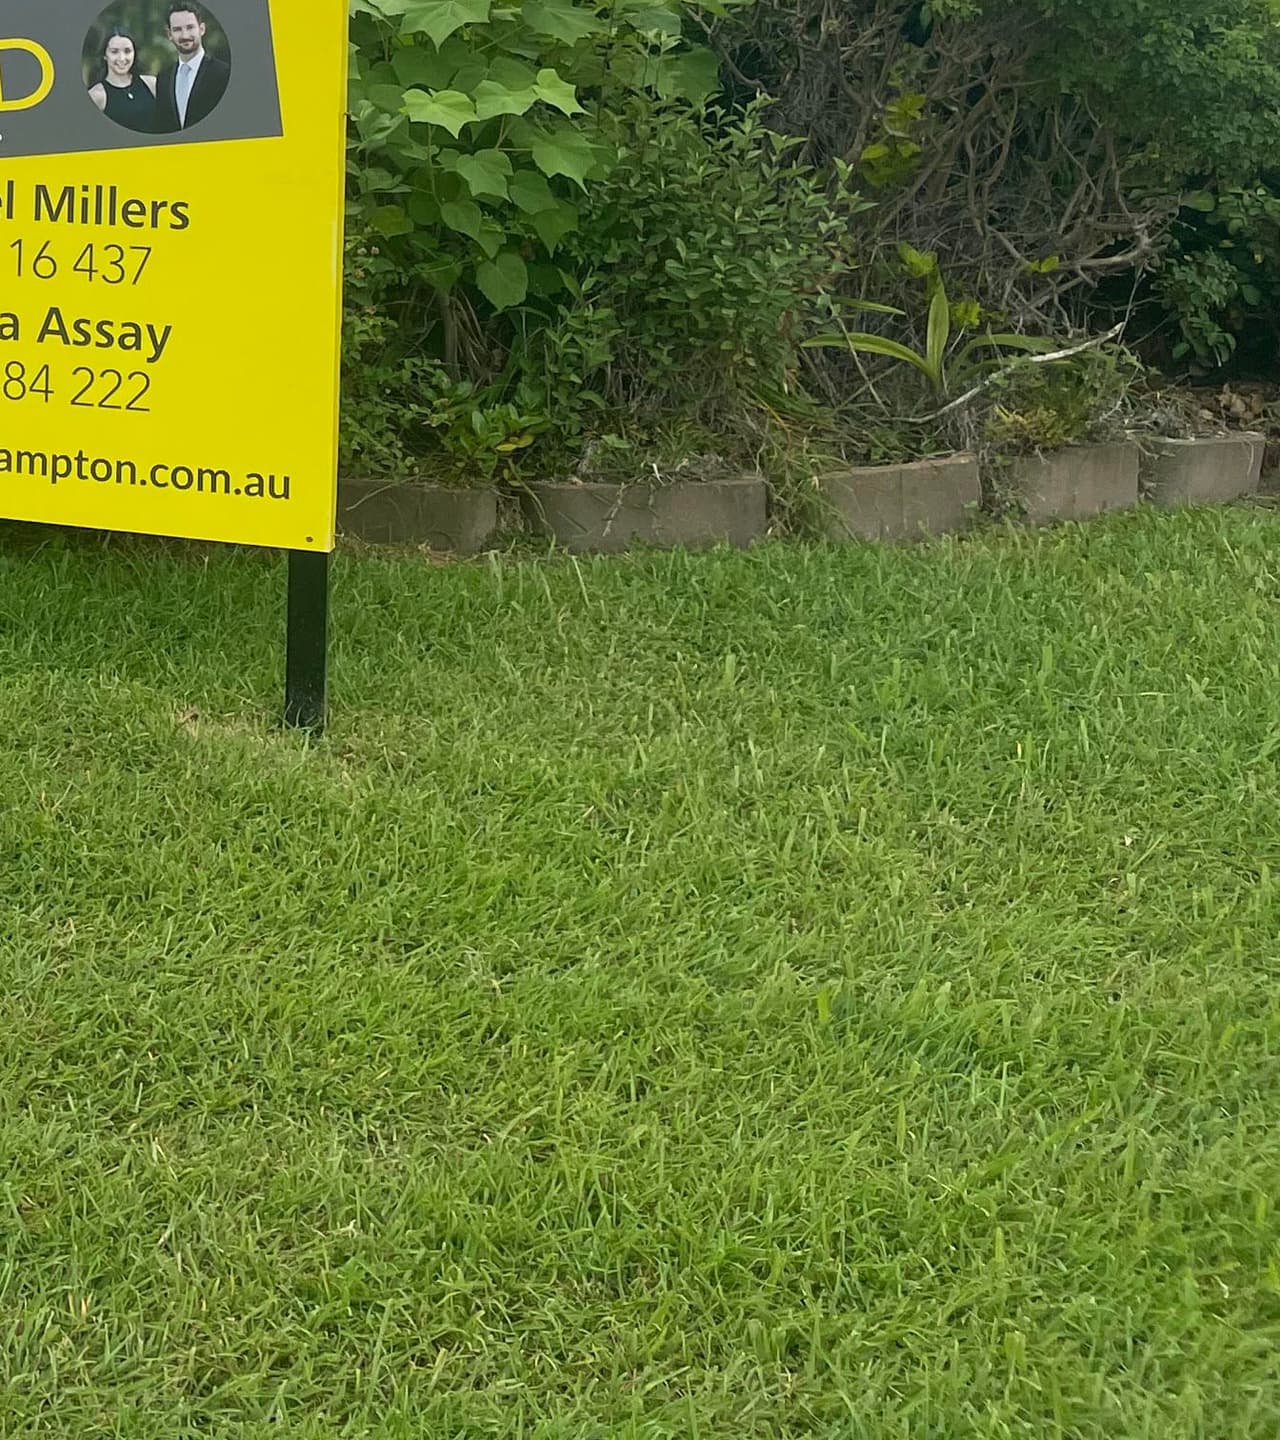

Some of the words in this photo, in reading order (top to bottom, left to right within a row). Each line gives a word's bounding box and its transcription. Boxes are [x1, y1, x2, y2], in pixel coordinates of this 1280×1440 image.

[33, 183, 190, 230] Millers
[73, 242, 152, 285] 437
[37, 307, 172, 362] Assay
[71, 367, 150, 412] 222
